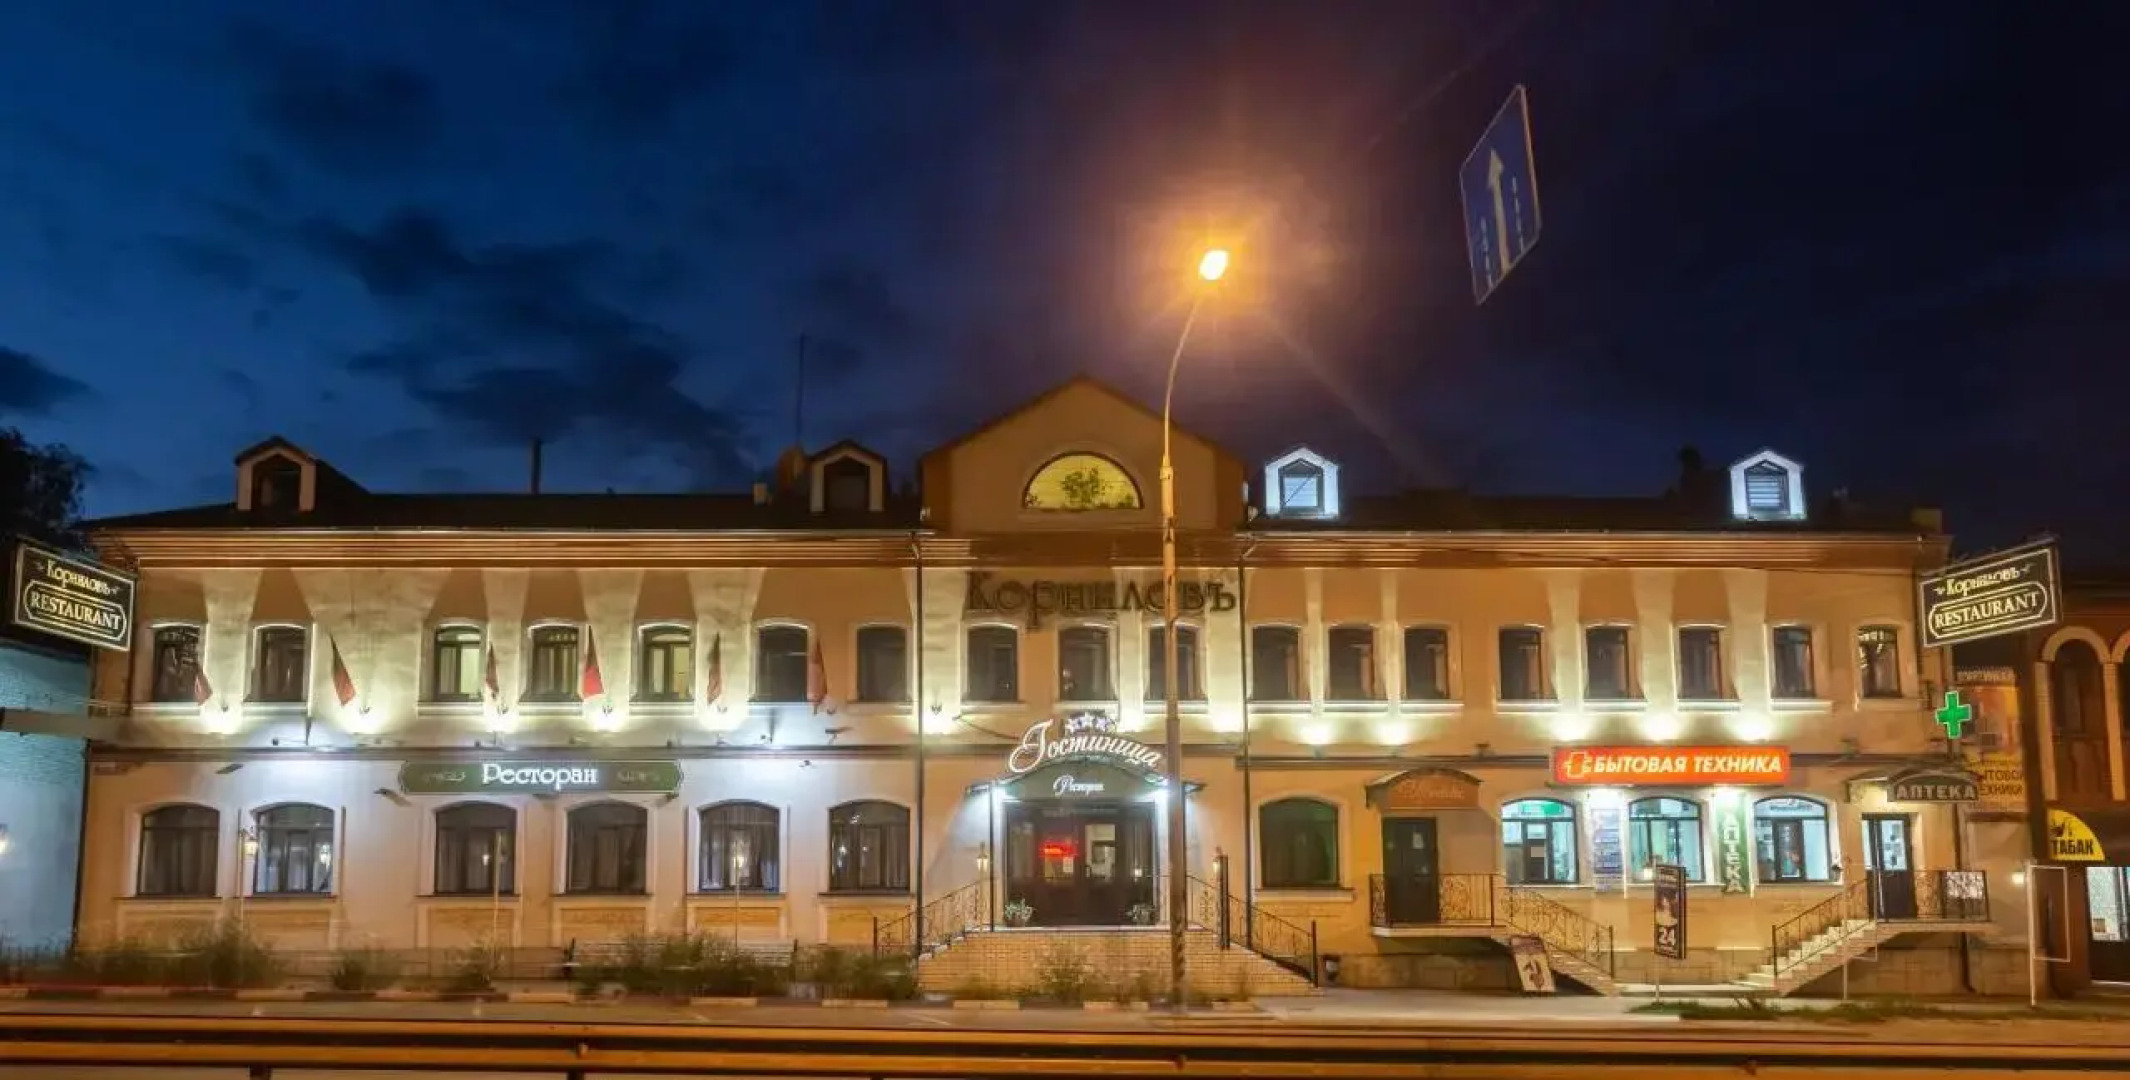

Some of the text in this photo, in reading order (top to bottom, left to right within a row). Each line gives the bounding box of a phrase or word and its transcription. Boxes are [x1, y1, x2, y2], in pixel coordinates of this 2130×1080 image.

[30, 590, 121, 630] RESTAURANT
[1934, 590, 2040, 628] RESTAURANT
[1008, 718, 1163, 774] Гостиница
[481, 762, 598, 791] Ресторан
[1593, 755, 1783, 774] БЫТОВАЯ ТЕХНИКА
[1896, 784, 1977, 800] АПТЕКА
[1722, 812, 1745, 893] АПТЕКА
[2050, 838, 2095, 856] ТАБАК
[1658, 924, 1676, 946] 24
